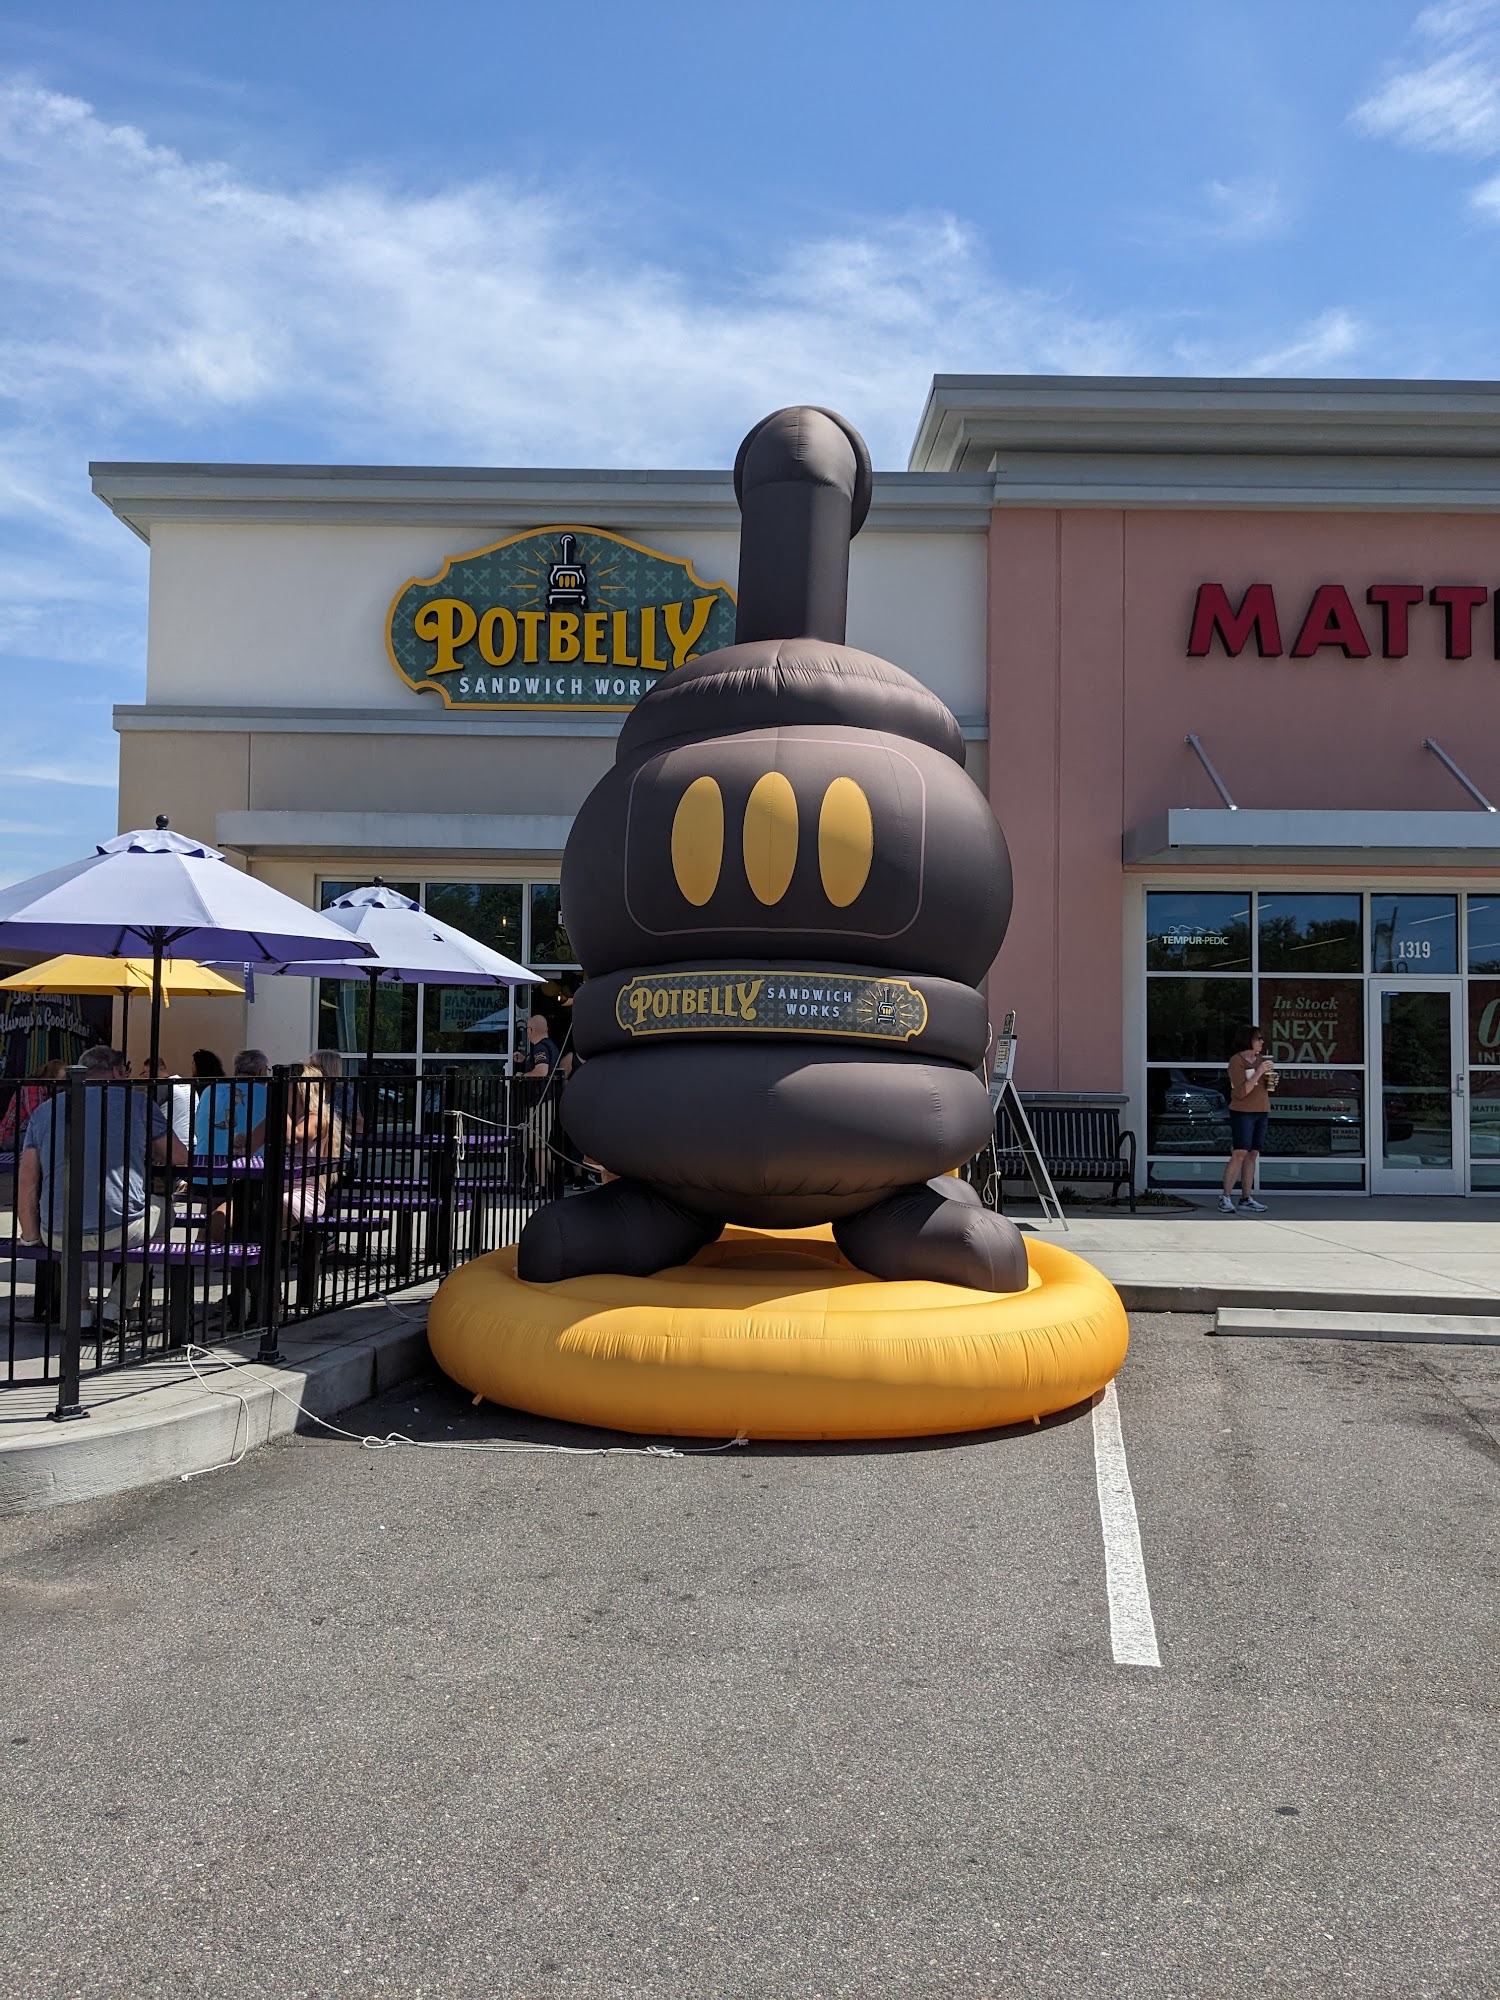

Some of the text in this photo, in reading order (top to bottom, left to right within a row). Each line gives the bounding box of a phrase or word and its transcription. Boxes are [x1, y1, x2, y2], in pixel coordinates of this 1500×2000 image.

[1187, 583, 1500, 660] MATT
[414, 594, 719, 676] POTBELLY
[459, 677, 658, 696] SANDWICH WORK
[1162, 935, 1230, 946] TEMPUR-PEDIC
[1398, 941, 1431, 959] 1319
[444, 996, 493, 1009] BANANA
[629, 979, 765, 1025] POTBELLY
[767, 987, 852, 1003] SANDWICH
[1274, 996, 1339, 1010] In Stock
[786, 1003, 840, 1017] WORKS
[45, 1007, 66, 1032] Good
[1272, 1019, 1339, 1040] NEXT
[1272, 1041, 1338, 1064] DAY
[1305, 1104, 1350, 1113] Warehouse
